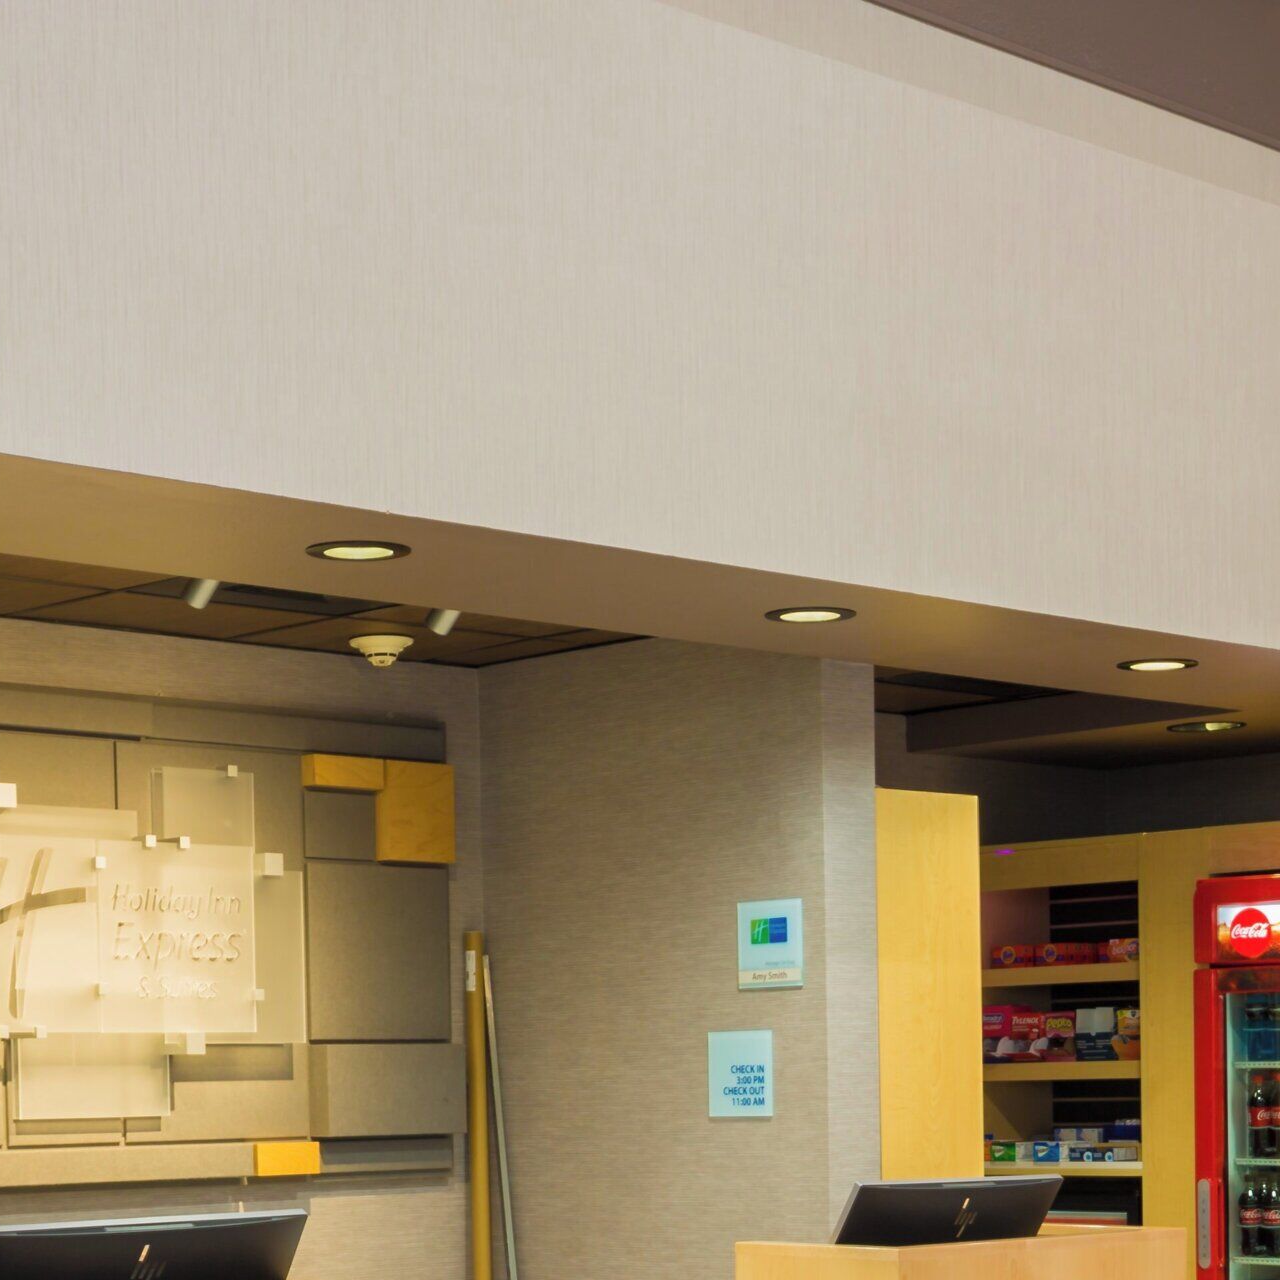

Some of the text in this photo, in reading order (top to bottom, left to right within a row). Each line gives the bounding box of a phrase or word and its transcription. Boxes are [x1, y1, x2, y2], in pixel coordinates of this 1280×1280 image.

[111, 882, 242, 922] Holiday Inn
[111, 922, 243, 978] Express
[752, 970, 788, 983] Amy Smith
[157, 974, 218, 1000] Suites
[730, 1064, 765, 1074] CHECK IN
[736, 1075, 765, 1085] 3:00 PM
[723, 1086, 765, 1096] CHECK OUT
[732, 1097, 765, 1107] 11:00 AM
